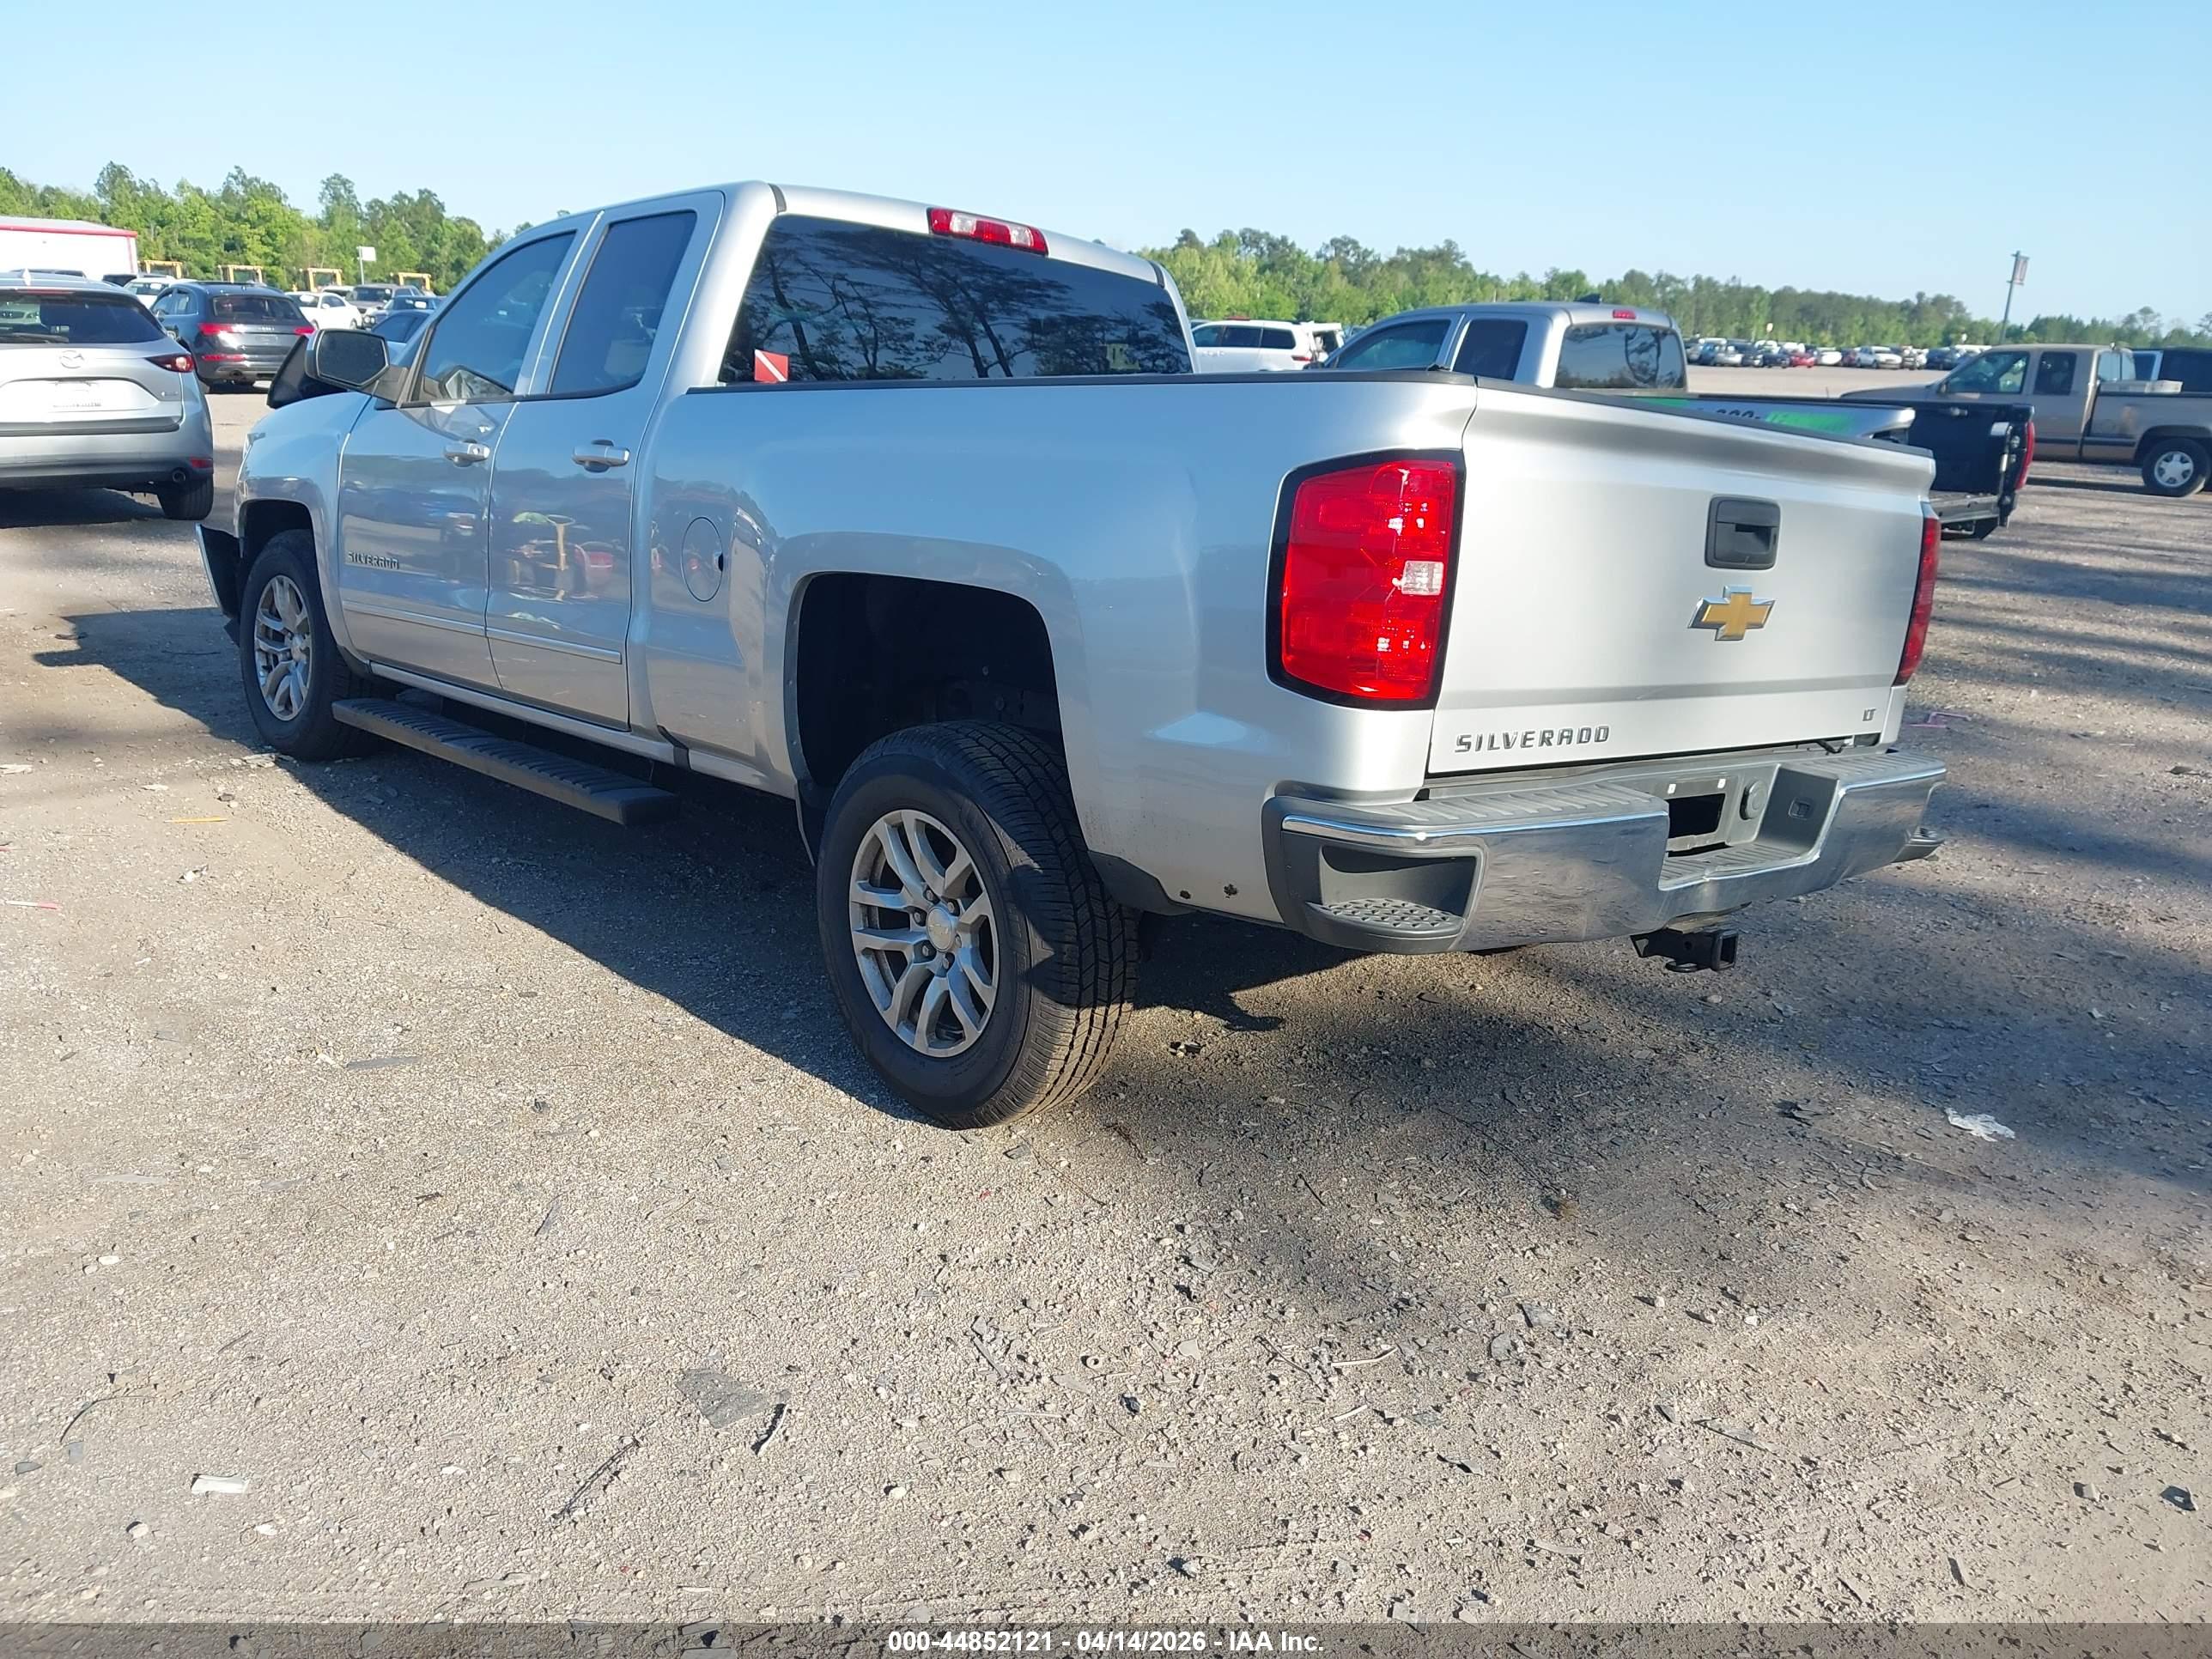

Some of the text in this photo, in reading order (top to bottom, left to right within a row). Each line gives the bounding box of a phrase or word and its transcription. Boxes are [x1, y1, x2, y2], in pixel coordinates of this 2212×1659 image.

[348, 551, 399, 569] SILVERADO
[1863, 708, 1876, 721] LT
[1455, 726, 1609, 752] SILVERADO
